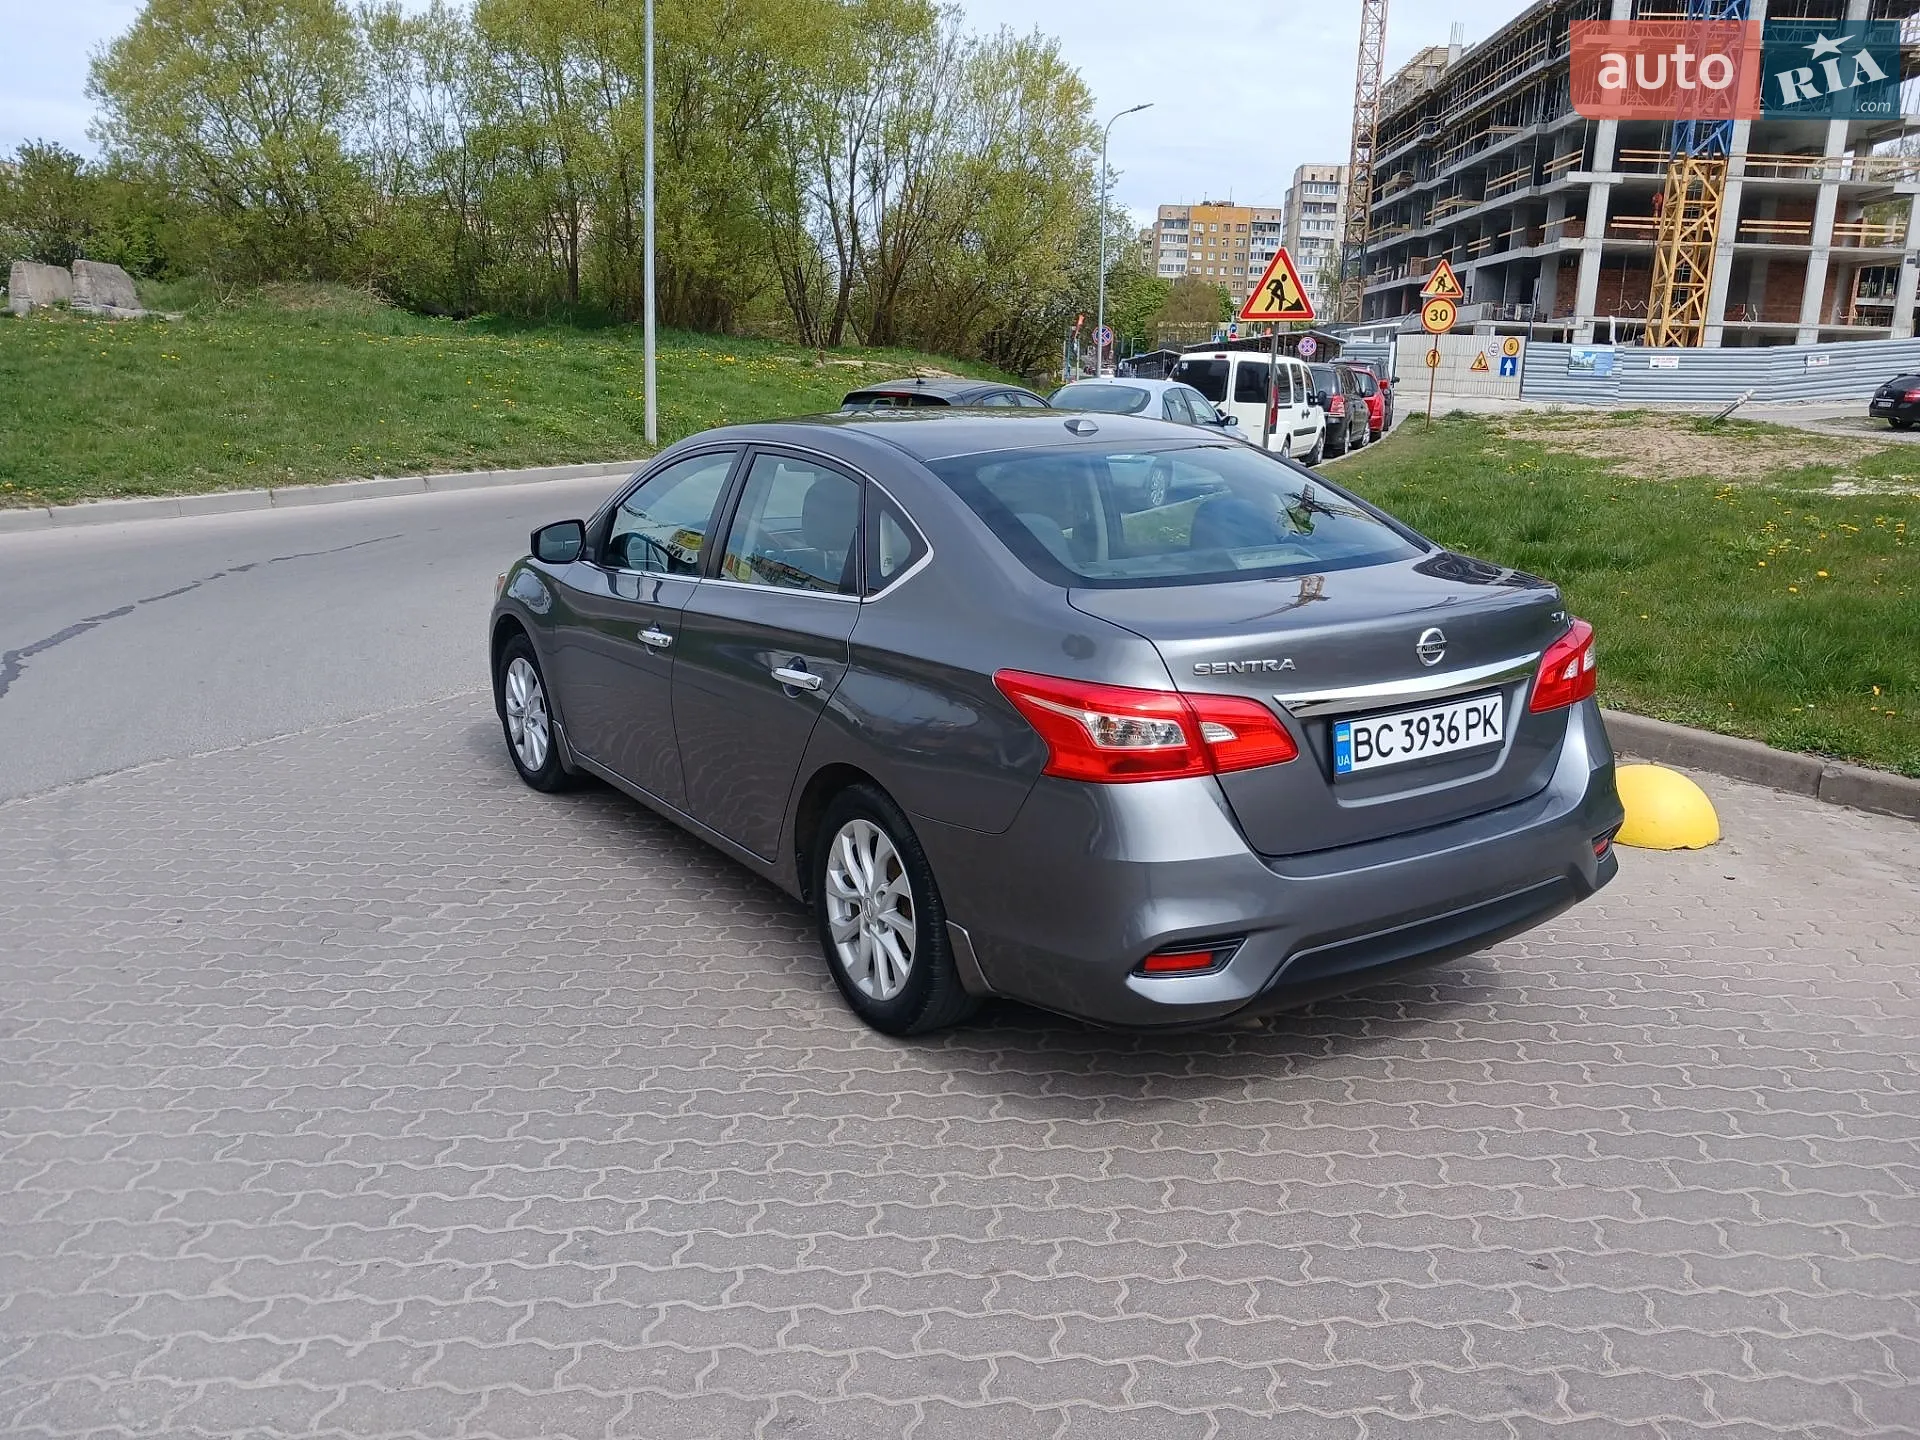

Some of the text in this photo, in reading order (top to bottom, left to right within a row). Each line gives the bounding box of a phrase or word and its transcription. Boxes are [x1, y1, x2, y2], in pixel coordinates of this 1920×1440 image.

[1429, 309, 1448, 322] 30
[1193, 658, 1297, 676] SENTRA
[1353, 702, 1499, 763] BC 3936 PK
[1337, 754, 1350, 767] UA
